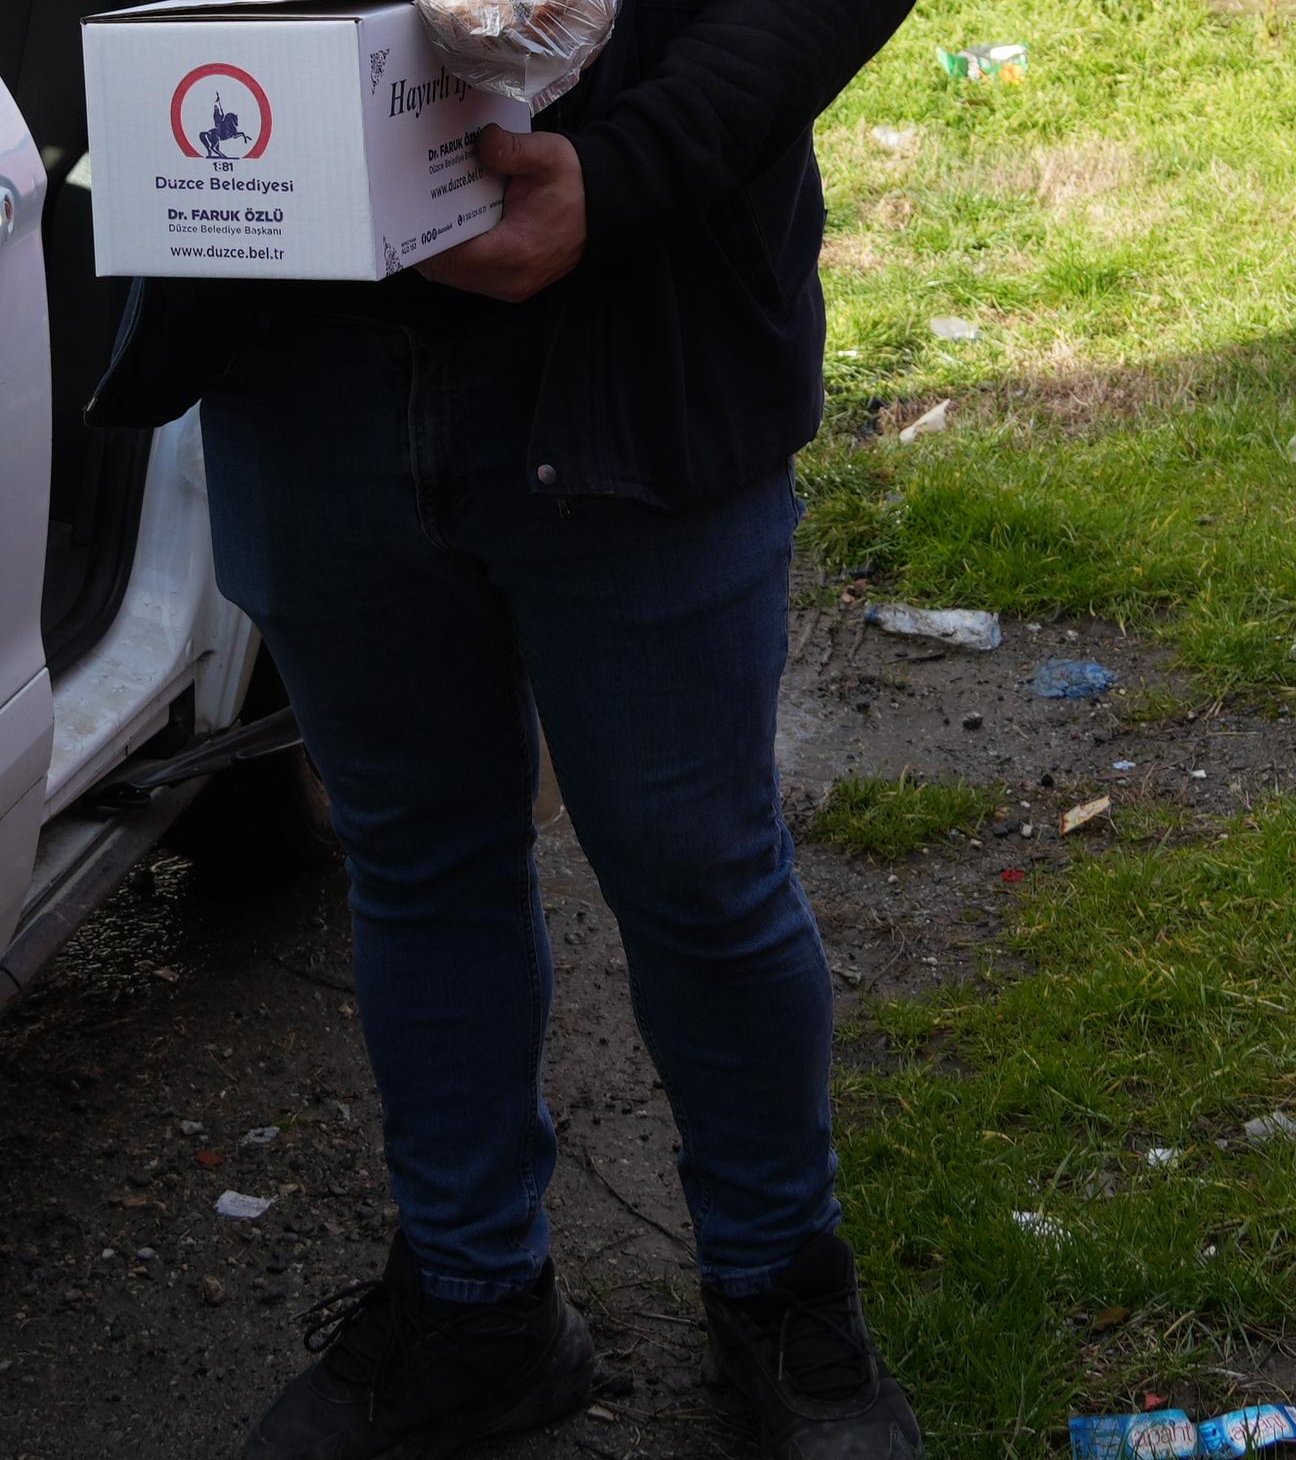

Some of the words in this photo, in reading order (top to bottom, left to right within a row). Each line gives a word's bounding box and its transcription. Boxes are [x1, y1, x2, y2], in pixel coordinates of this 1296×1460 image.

[428, 149, 439, 162] Dr.
[440, 136, 464, 157] FARUK
[209, 177, 294, 195] Belediyesi
[167, 208, 188, 221] Dr.
[191, 209, 241, 222] FARUK
[244, 207, 284, 223] ÖZLÜ
[168, 223, 198, 234] Düzce
[200, 224, 242, 236] Belediye
[244, 225, 282, 237] Başkanı
[170, 245, 285, 260] www.duzce.bel.tr
